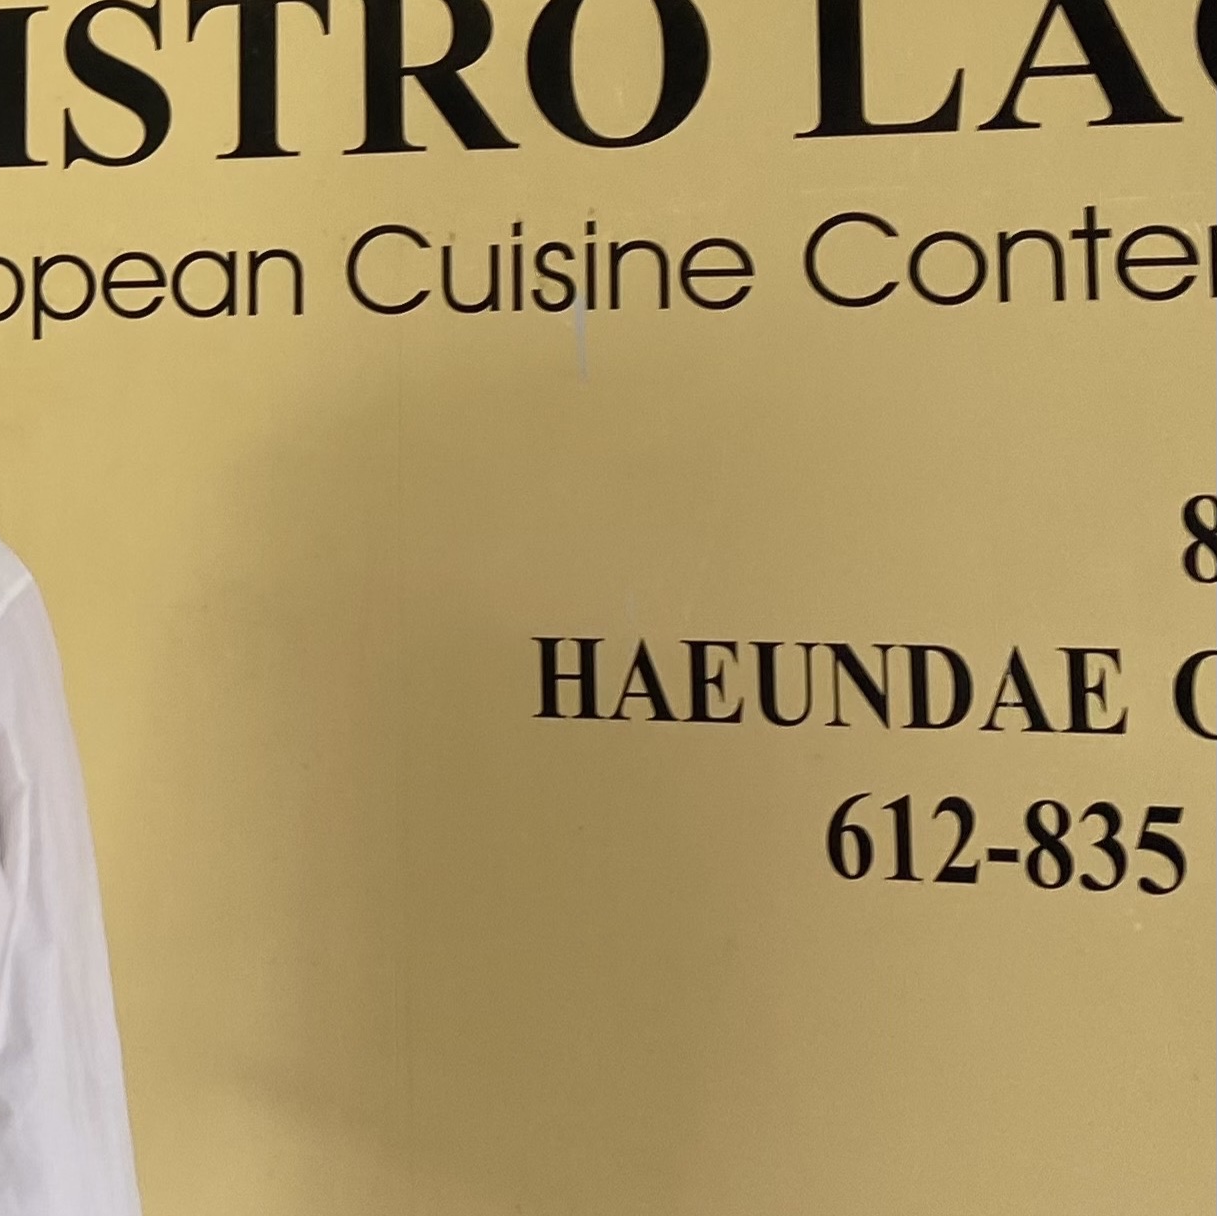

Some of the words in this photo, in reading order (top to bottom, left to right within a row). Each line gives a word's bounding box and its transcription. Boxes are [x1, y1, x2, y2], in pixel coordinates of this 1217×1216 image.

[793, 0, 1217, 139] LA
[346, 220, 755, 314] Cuisine
[804, 205, 1217, 307] Conte
[531, 636, 1128, 735] HAEUNDAE
[827, 792, 1186, 895] 612-835
